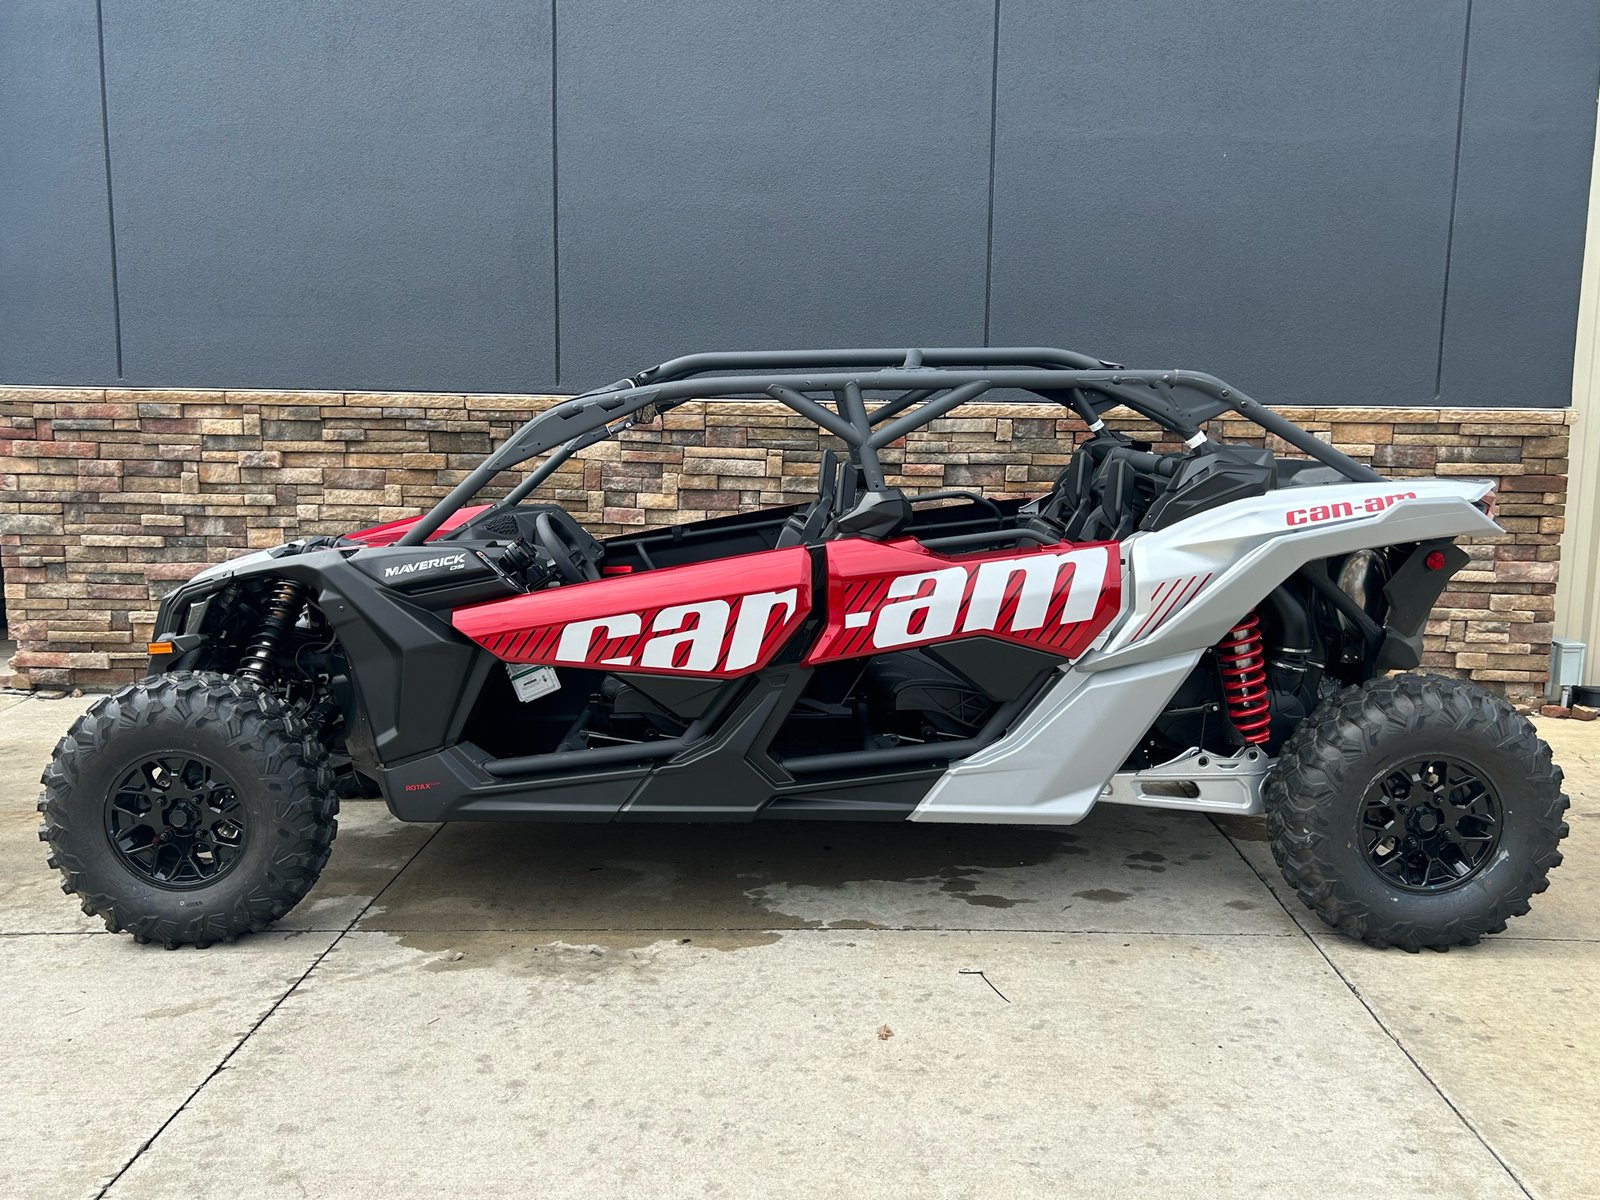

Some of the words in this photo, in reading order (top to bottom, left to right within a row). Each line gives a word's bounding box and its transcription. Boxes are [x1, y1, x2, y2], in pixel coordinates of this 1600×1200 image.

[384, 553, 467, 578] MAVERICK
[449, 563, 465, 571] DS
[405, 783, 431, 791] ROTAX
